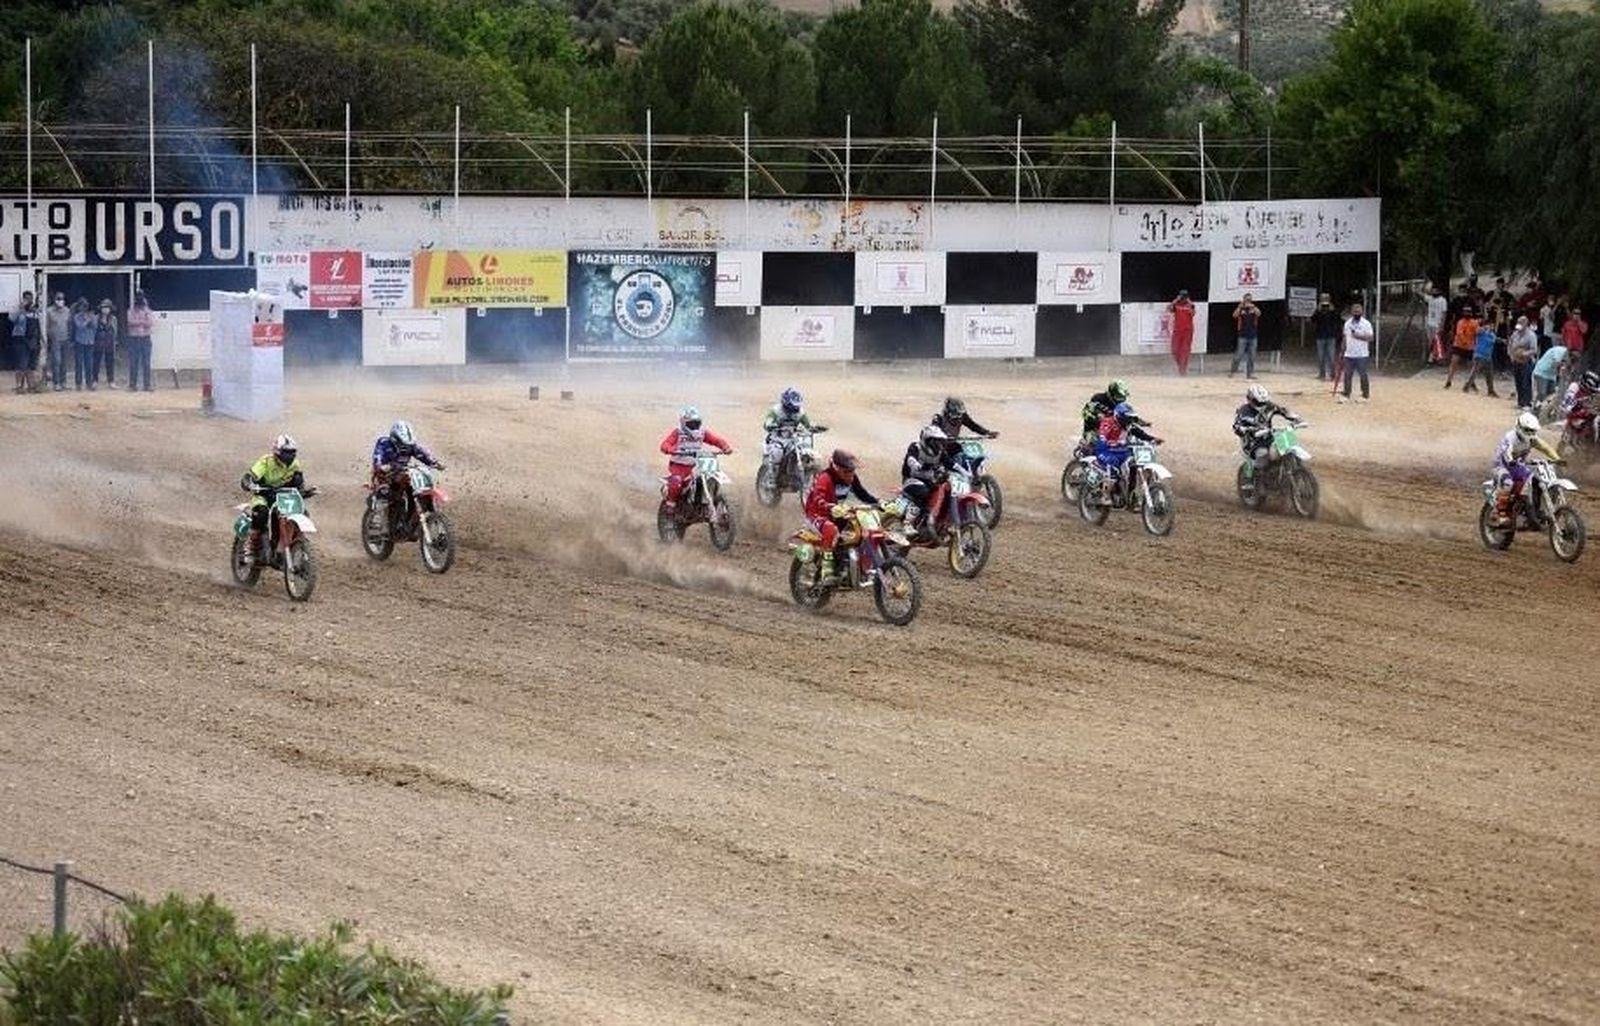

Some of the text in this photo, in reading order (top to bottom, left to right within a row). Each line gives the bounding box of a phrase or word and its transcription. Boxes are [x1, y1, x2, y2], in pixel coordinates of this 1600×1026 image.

[0, 201, 71, 229] TO
[96, 201, 240, 262] URSO
[446, 277, 484, 286] AUTOS
[284, 500, 295, 513] 7
